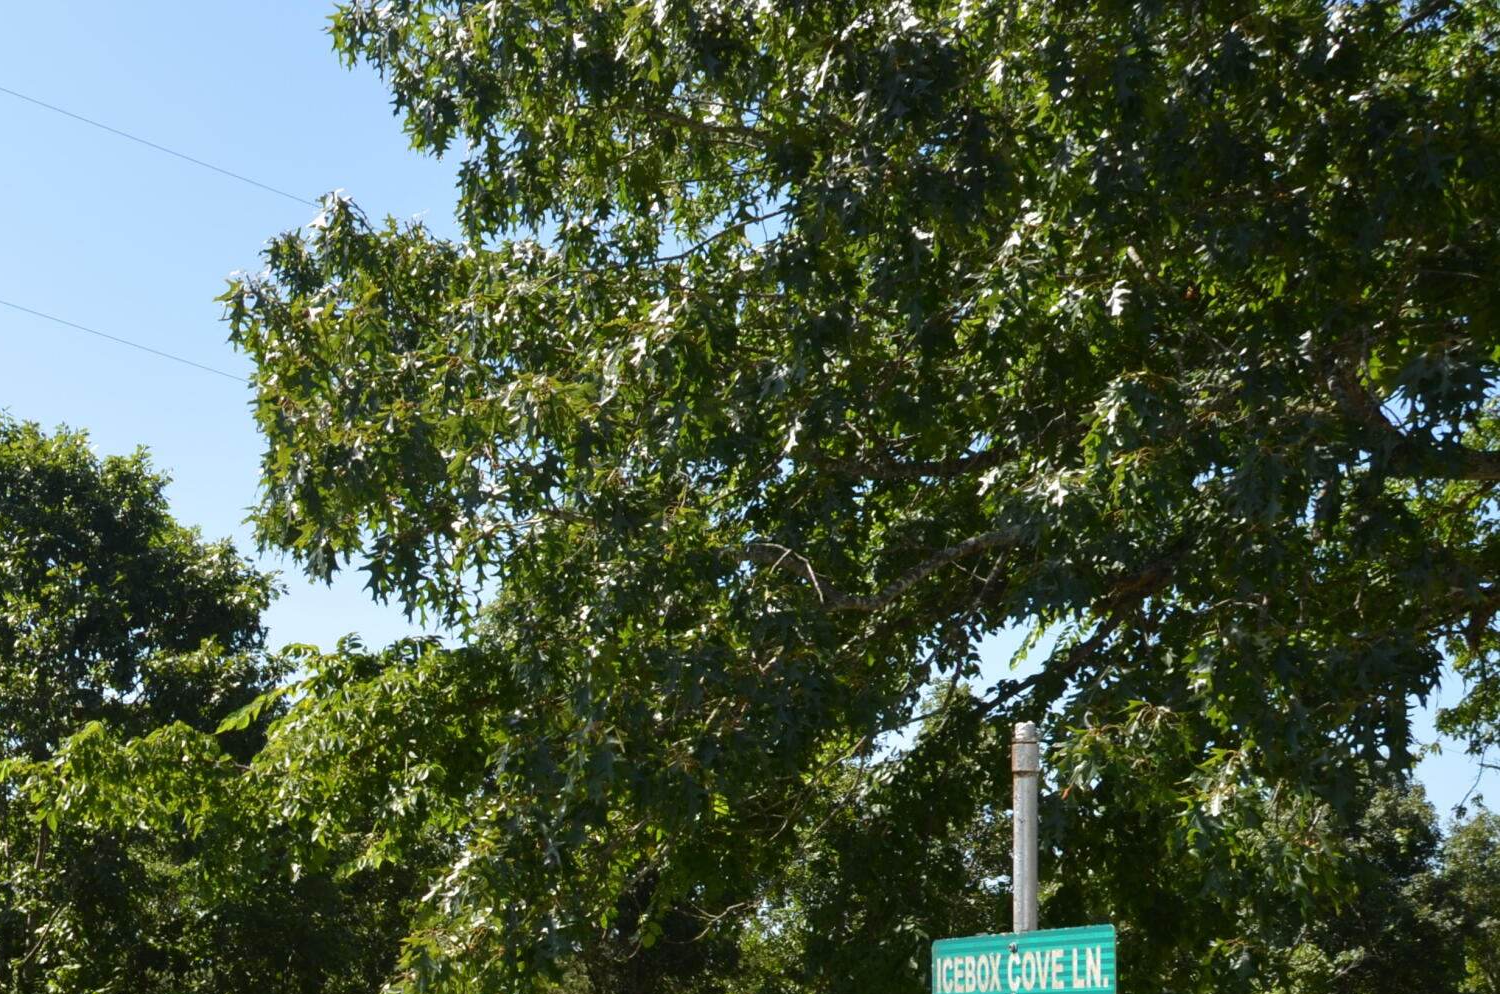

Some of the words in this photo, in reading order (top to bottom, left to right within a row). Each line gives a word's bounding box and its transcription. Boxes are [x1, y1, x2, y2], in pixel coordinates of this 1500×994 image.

[936, 952, 1002, 994] ICEBOX
[1007, 948, 1065, 991] COVE
[1072, 945, 1109, 989] LN.
